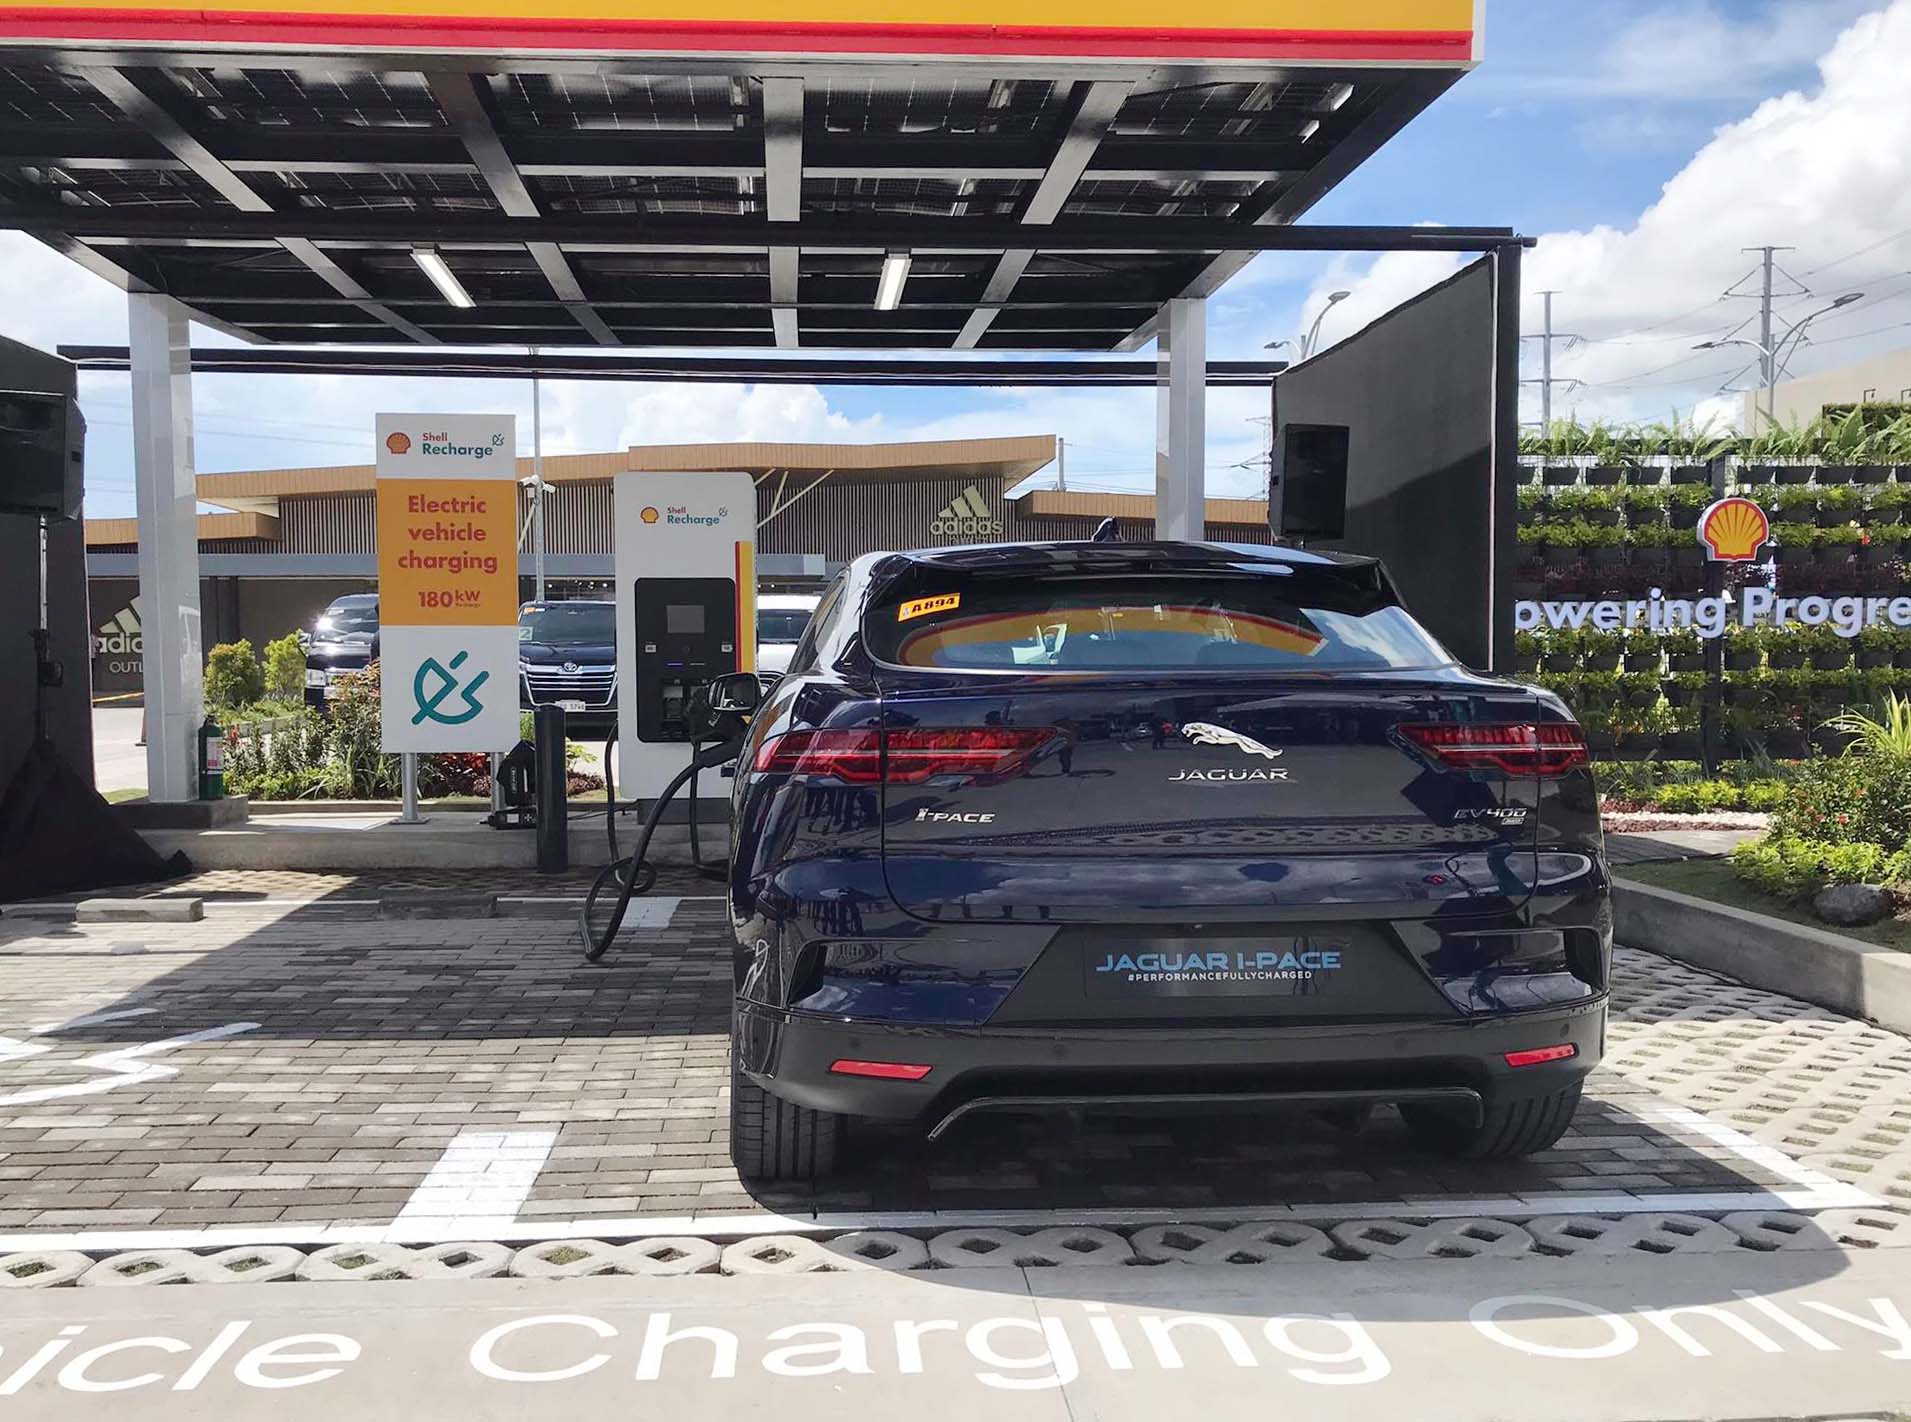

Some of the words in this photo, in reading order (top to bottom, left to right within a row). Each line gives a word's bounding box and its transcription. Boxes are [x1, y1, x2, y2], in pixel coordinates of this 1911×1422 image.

[422, 432, 448, 442] Shell
[422, 443, 494, 459] Recharge
[408, 494, 487, 514] Electric
[667, 506, 687, 514] Shell
[667, 514, 720, 527] Recharge
[930, 517, 1004, 535] adidas
[408, 523, 487, 541] vehicle
[398, 550, 498, 574] charging
[418, 590, 453, 608] 180
[455, 589, 481, 601] kW
[912, 597, 955, 613] A894
[1743, 586, 1911, 639] Progre
[1168, 768, 1289, 781] JAGUAR
[1096, 952, 1229, 972] JAGUAR
[1237, 951, 1342, 970] I-PACE
[1128, 970, 1312, 982] #PERFORMANCEFULLYCHARGED
[0, 1320, 363, 1396] icle
[469, 1312, 1392, 1390] Charging
[1468, 1288, 1911, 1361] Only
